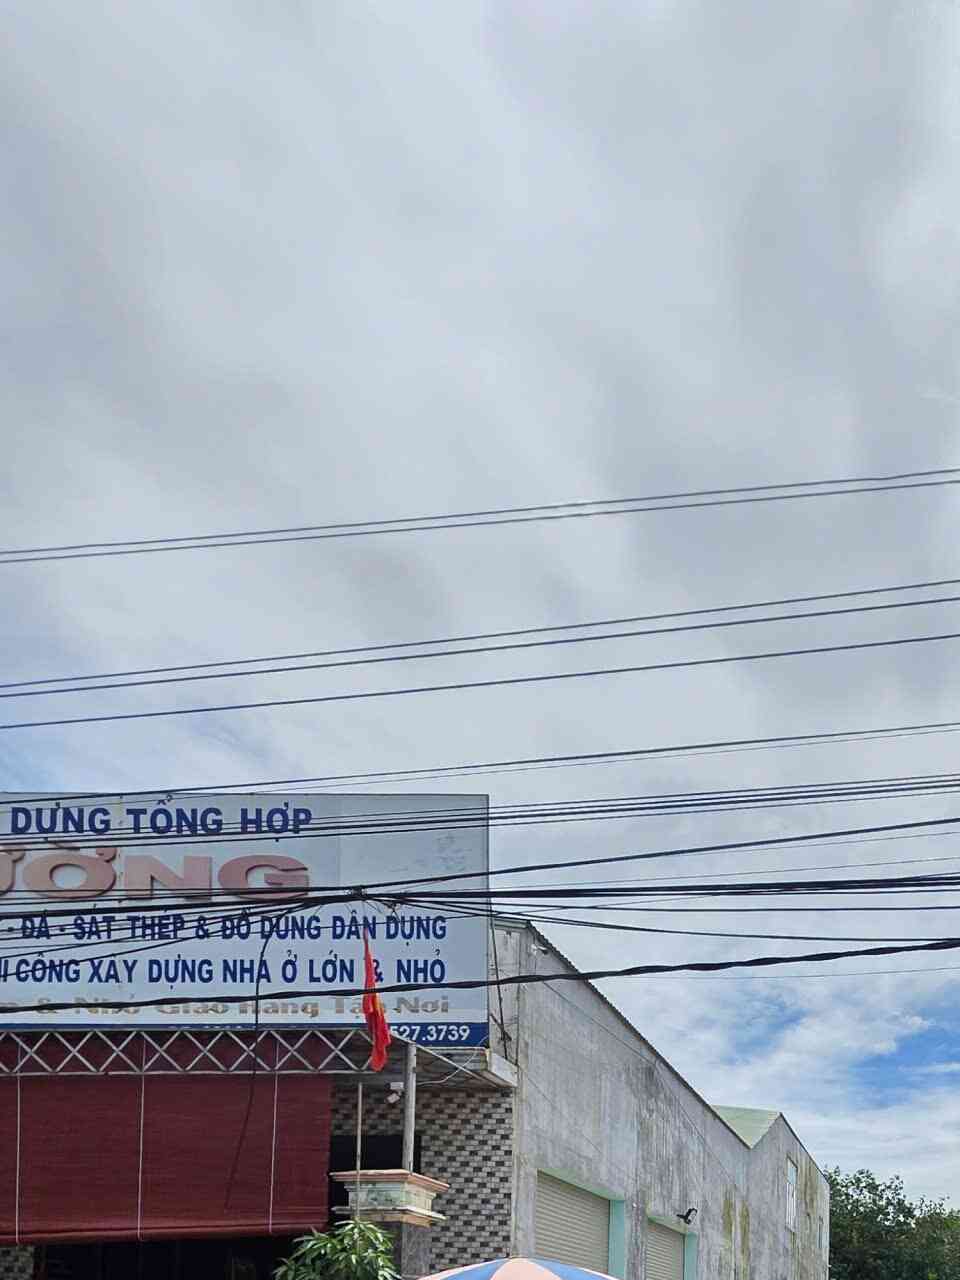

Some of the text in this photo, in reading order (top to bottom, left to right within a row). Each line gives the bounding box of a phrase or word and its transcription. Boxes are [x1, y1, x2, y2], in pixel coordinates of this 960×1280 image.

[126, 795, 223, 834] TỔNG
[196, 915, 209, 940] &
[386, 914, 446, 947] DỤNG
[15, 951, 80, 983] CÔNG
[148, 953, 213, 990] DỰNG
[281, 949, 298, 984] Ở
[309, 950, 354, 983] LỚN
[397, 949, 445, 983] NHỎ
